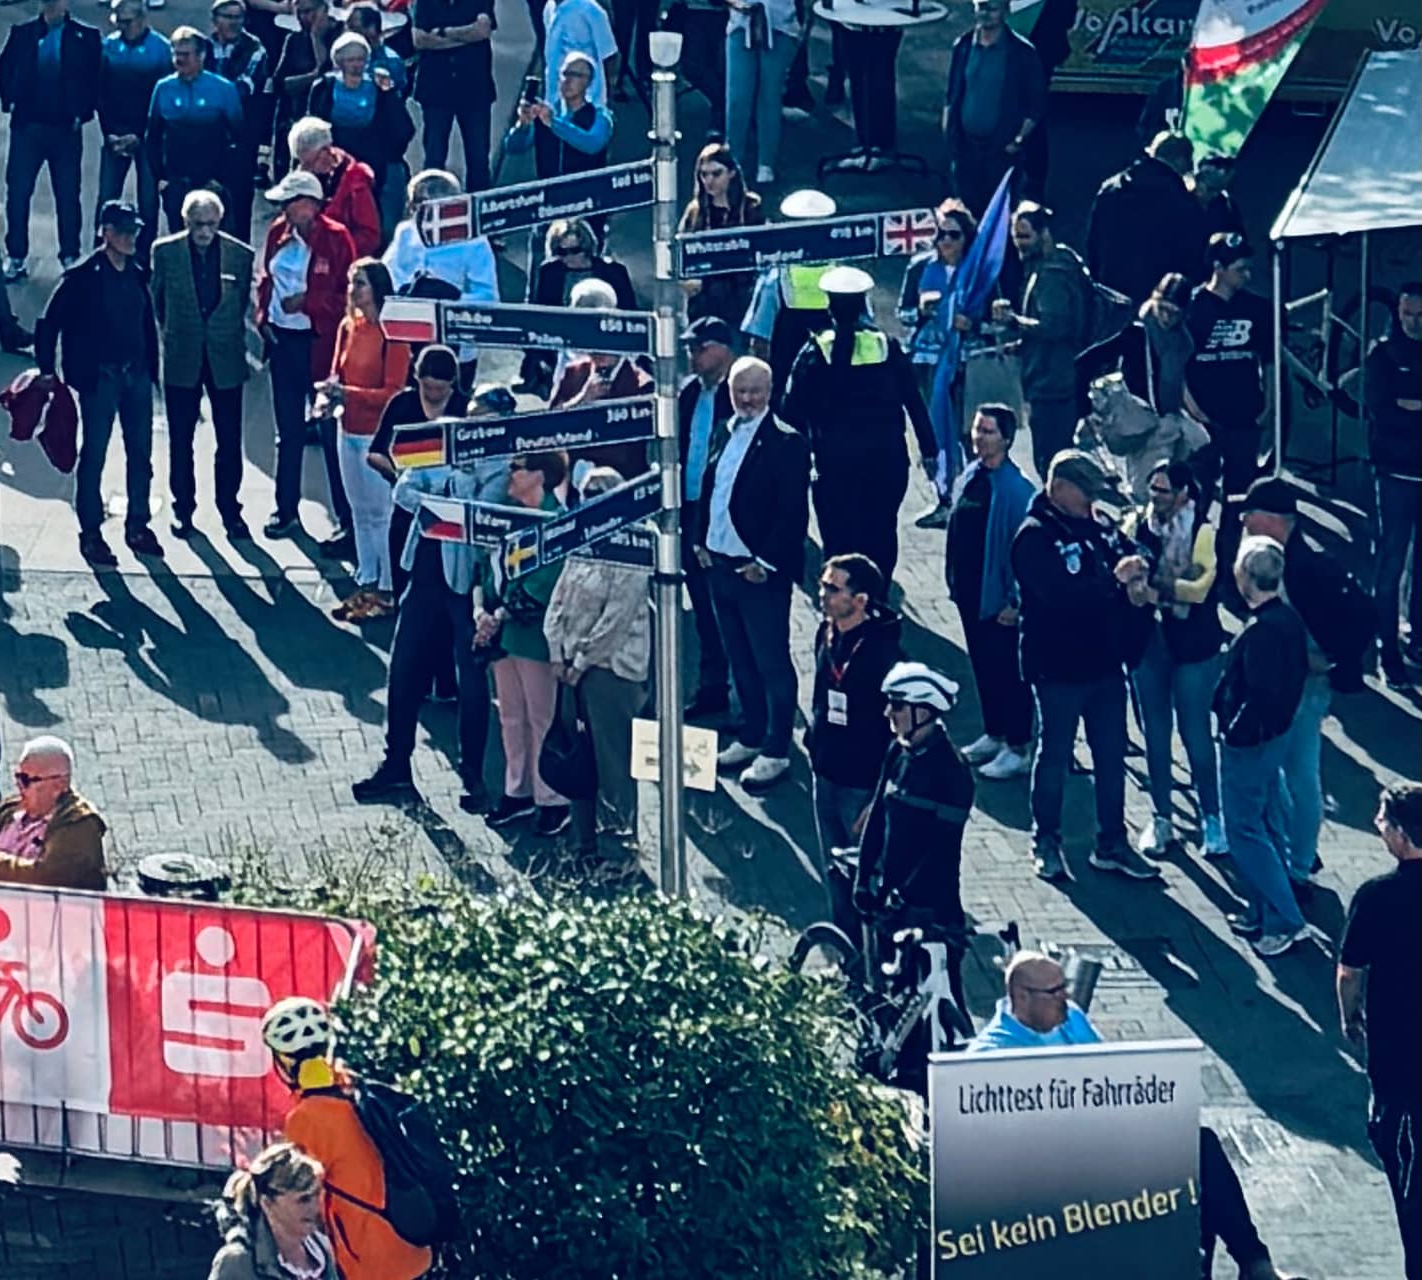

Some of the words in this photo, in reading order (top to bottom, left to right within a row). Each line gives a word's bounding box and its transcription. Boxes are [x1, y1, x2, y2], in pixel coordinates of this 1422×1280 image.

[959, 1083, 1043, 1114] Lichttest
[1049, 1078, 1076, 1109] für
[1082, 1074, 1176, 1107] Fahrräder
[936, 1223, 986, 1262] Sei
[990, 1213, 1057, 1251] kein
[1062, 1186, 1182, 1235] Blender
